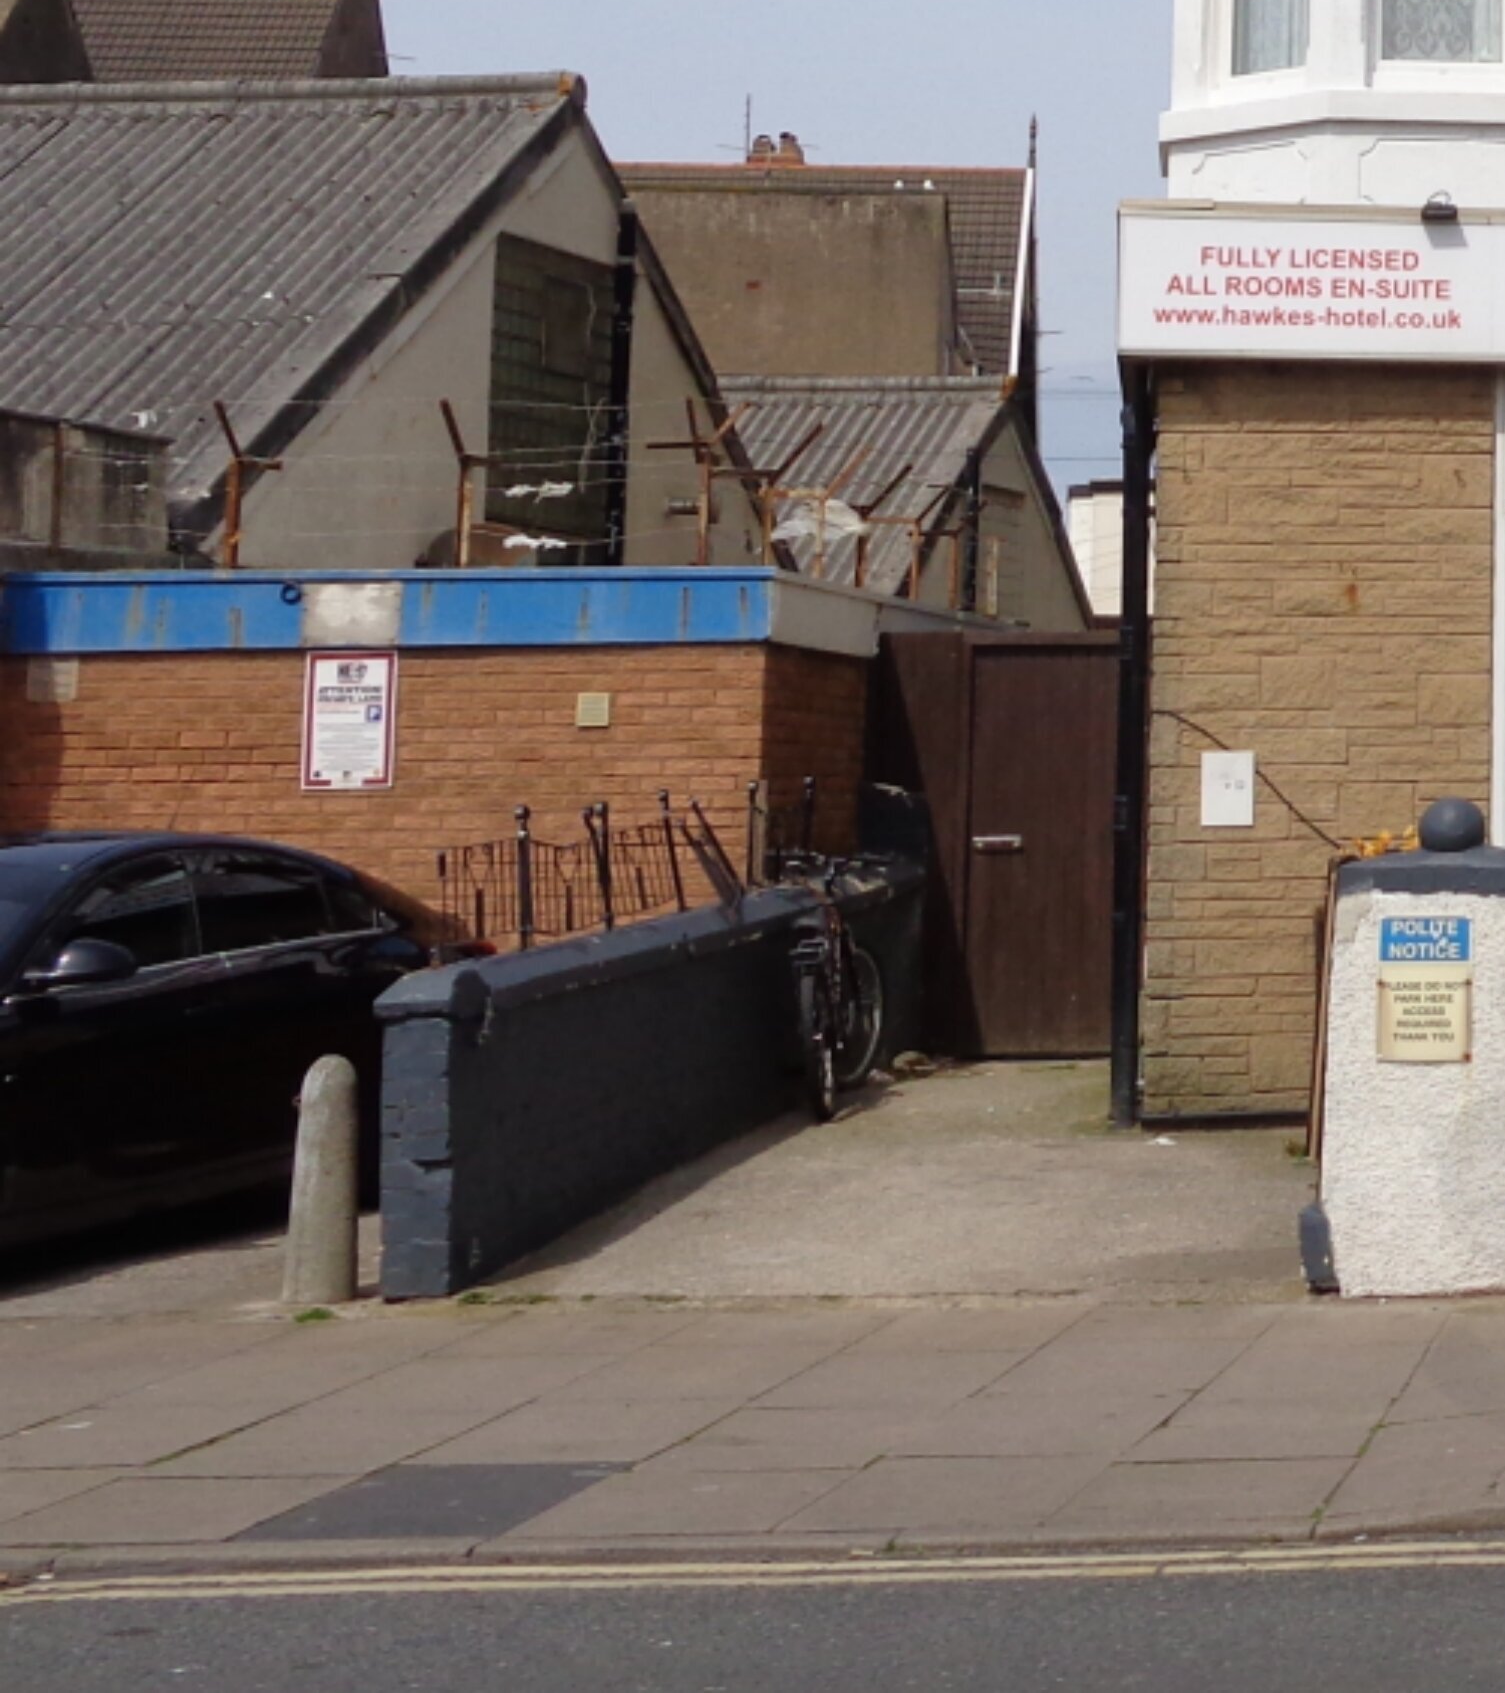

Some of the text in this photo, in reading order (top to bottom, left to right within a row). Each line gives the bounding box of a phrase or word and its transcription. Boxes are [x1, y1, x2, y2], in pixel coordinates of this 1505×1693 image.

[1200, 246, 1420, 271] FULLY LICENSED
[1166, 274, 1451, 300] ALL ROOMS EN-SUITE
[1153, 304, 1462, 329] www.hawkes-hotel.co.uk
[1390, 919, 1458, 936] POLITE
[1389, 942, 1461, 959] NOTICE
